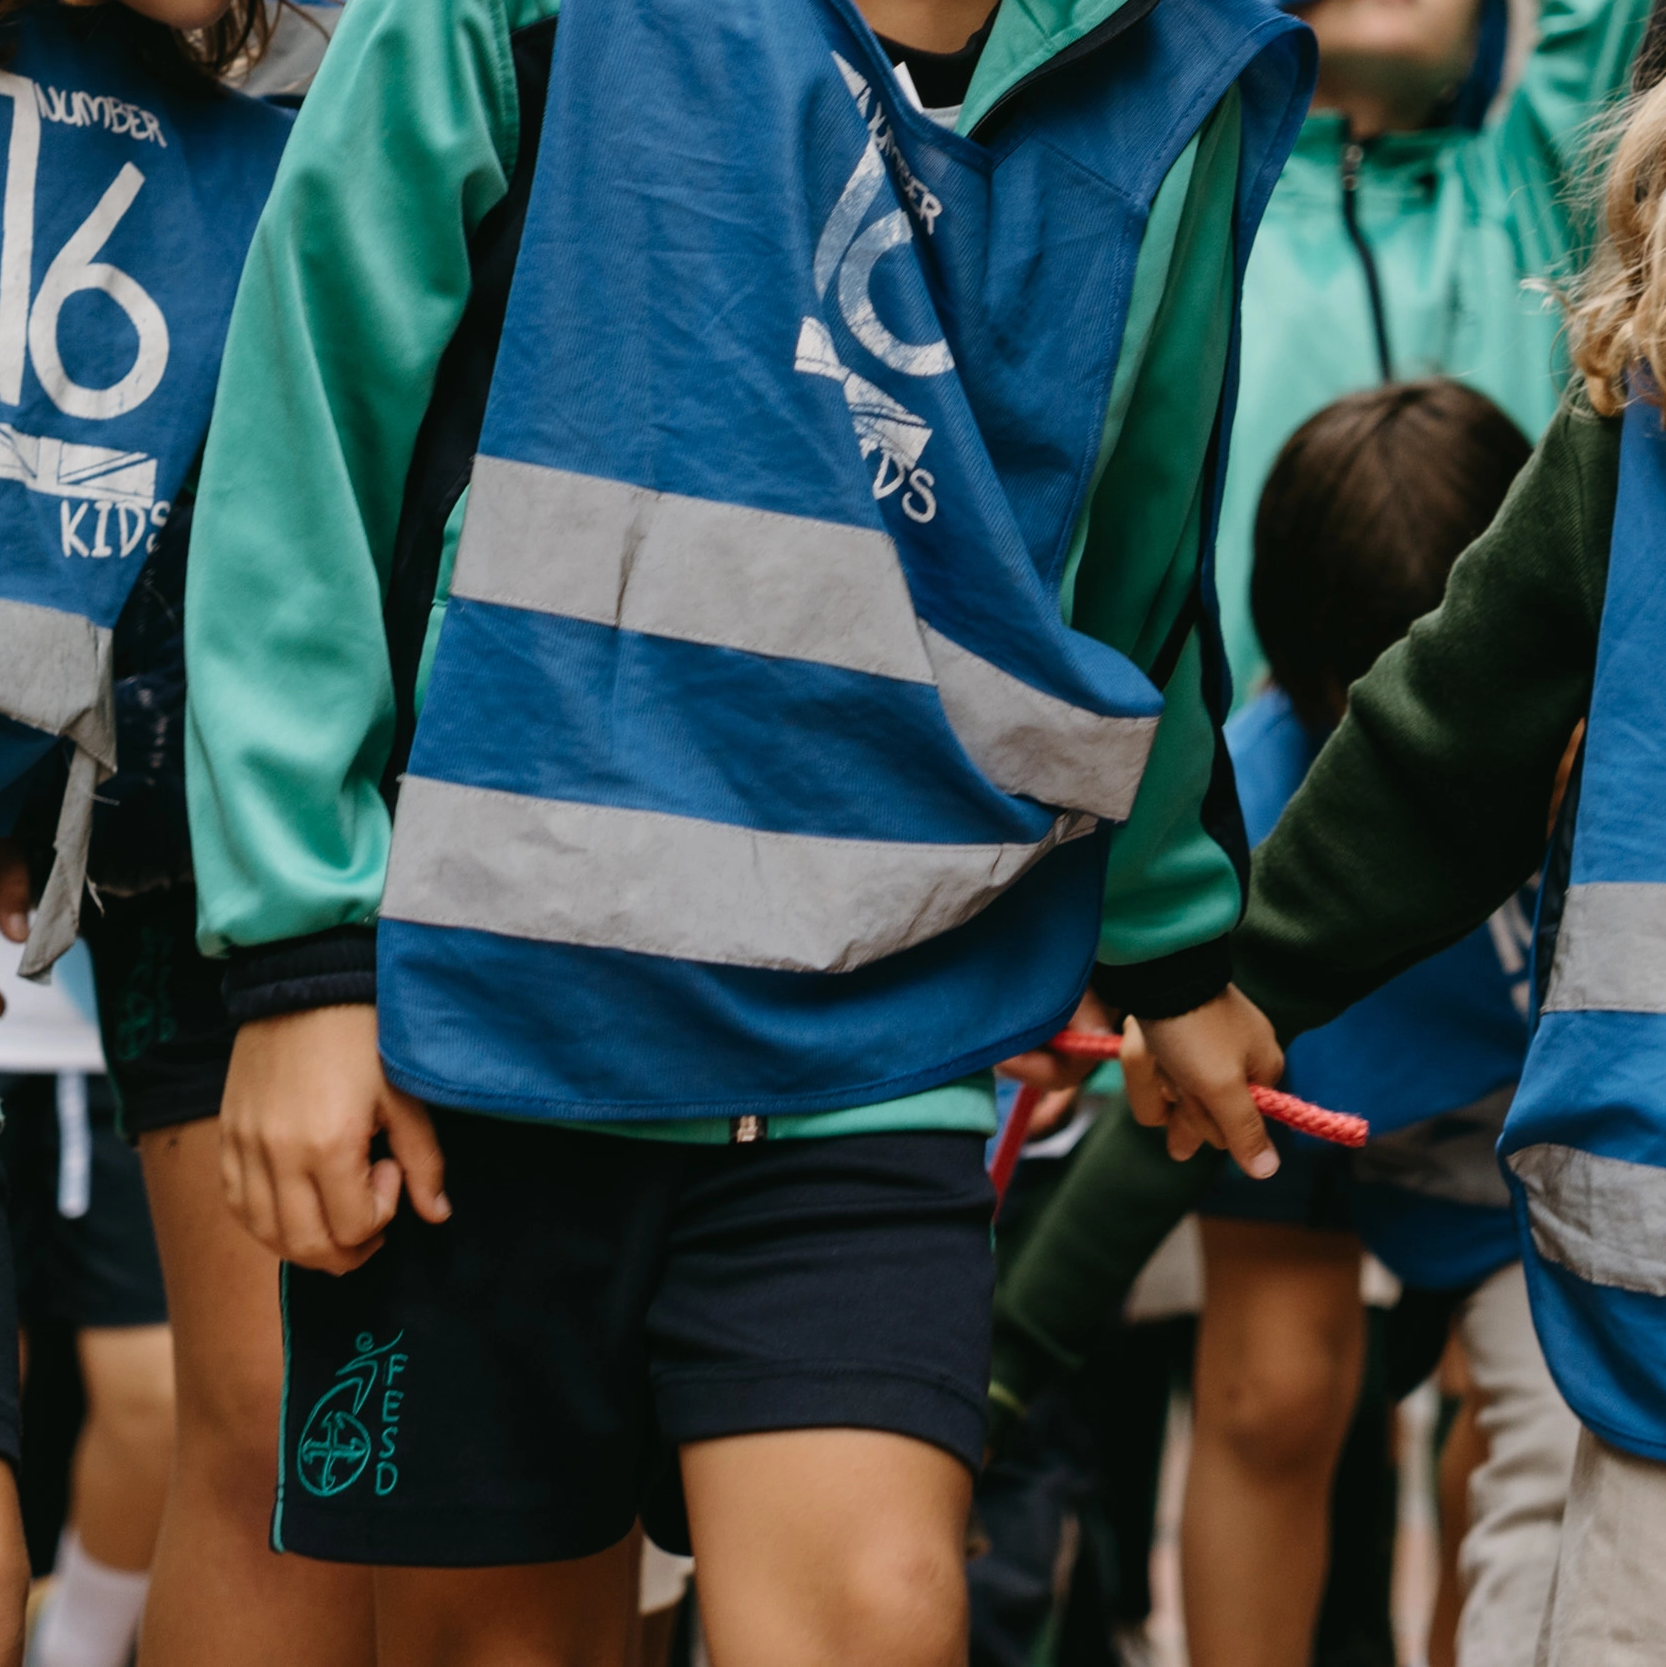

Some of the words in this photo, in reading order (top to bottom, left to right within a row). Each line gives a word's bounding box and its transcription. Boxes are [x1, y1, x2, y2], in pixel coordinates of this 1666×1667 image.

[34, 82, 167, 149] NUMBER
[60, 498, 171, 559] KIDS
[374, 1352, 409, 1497] FESD
